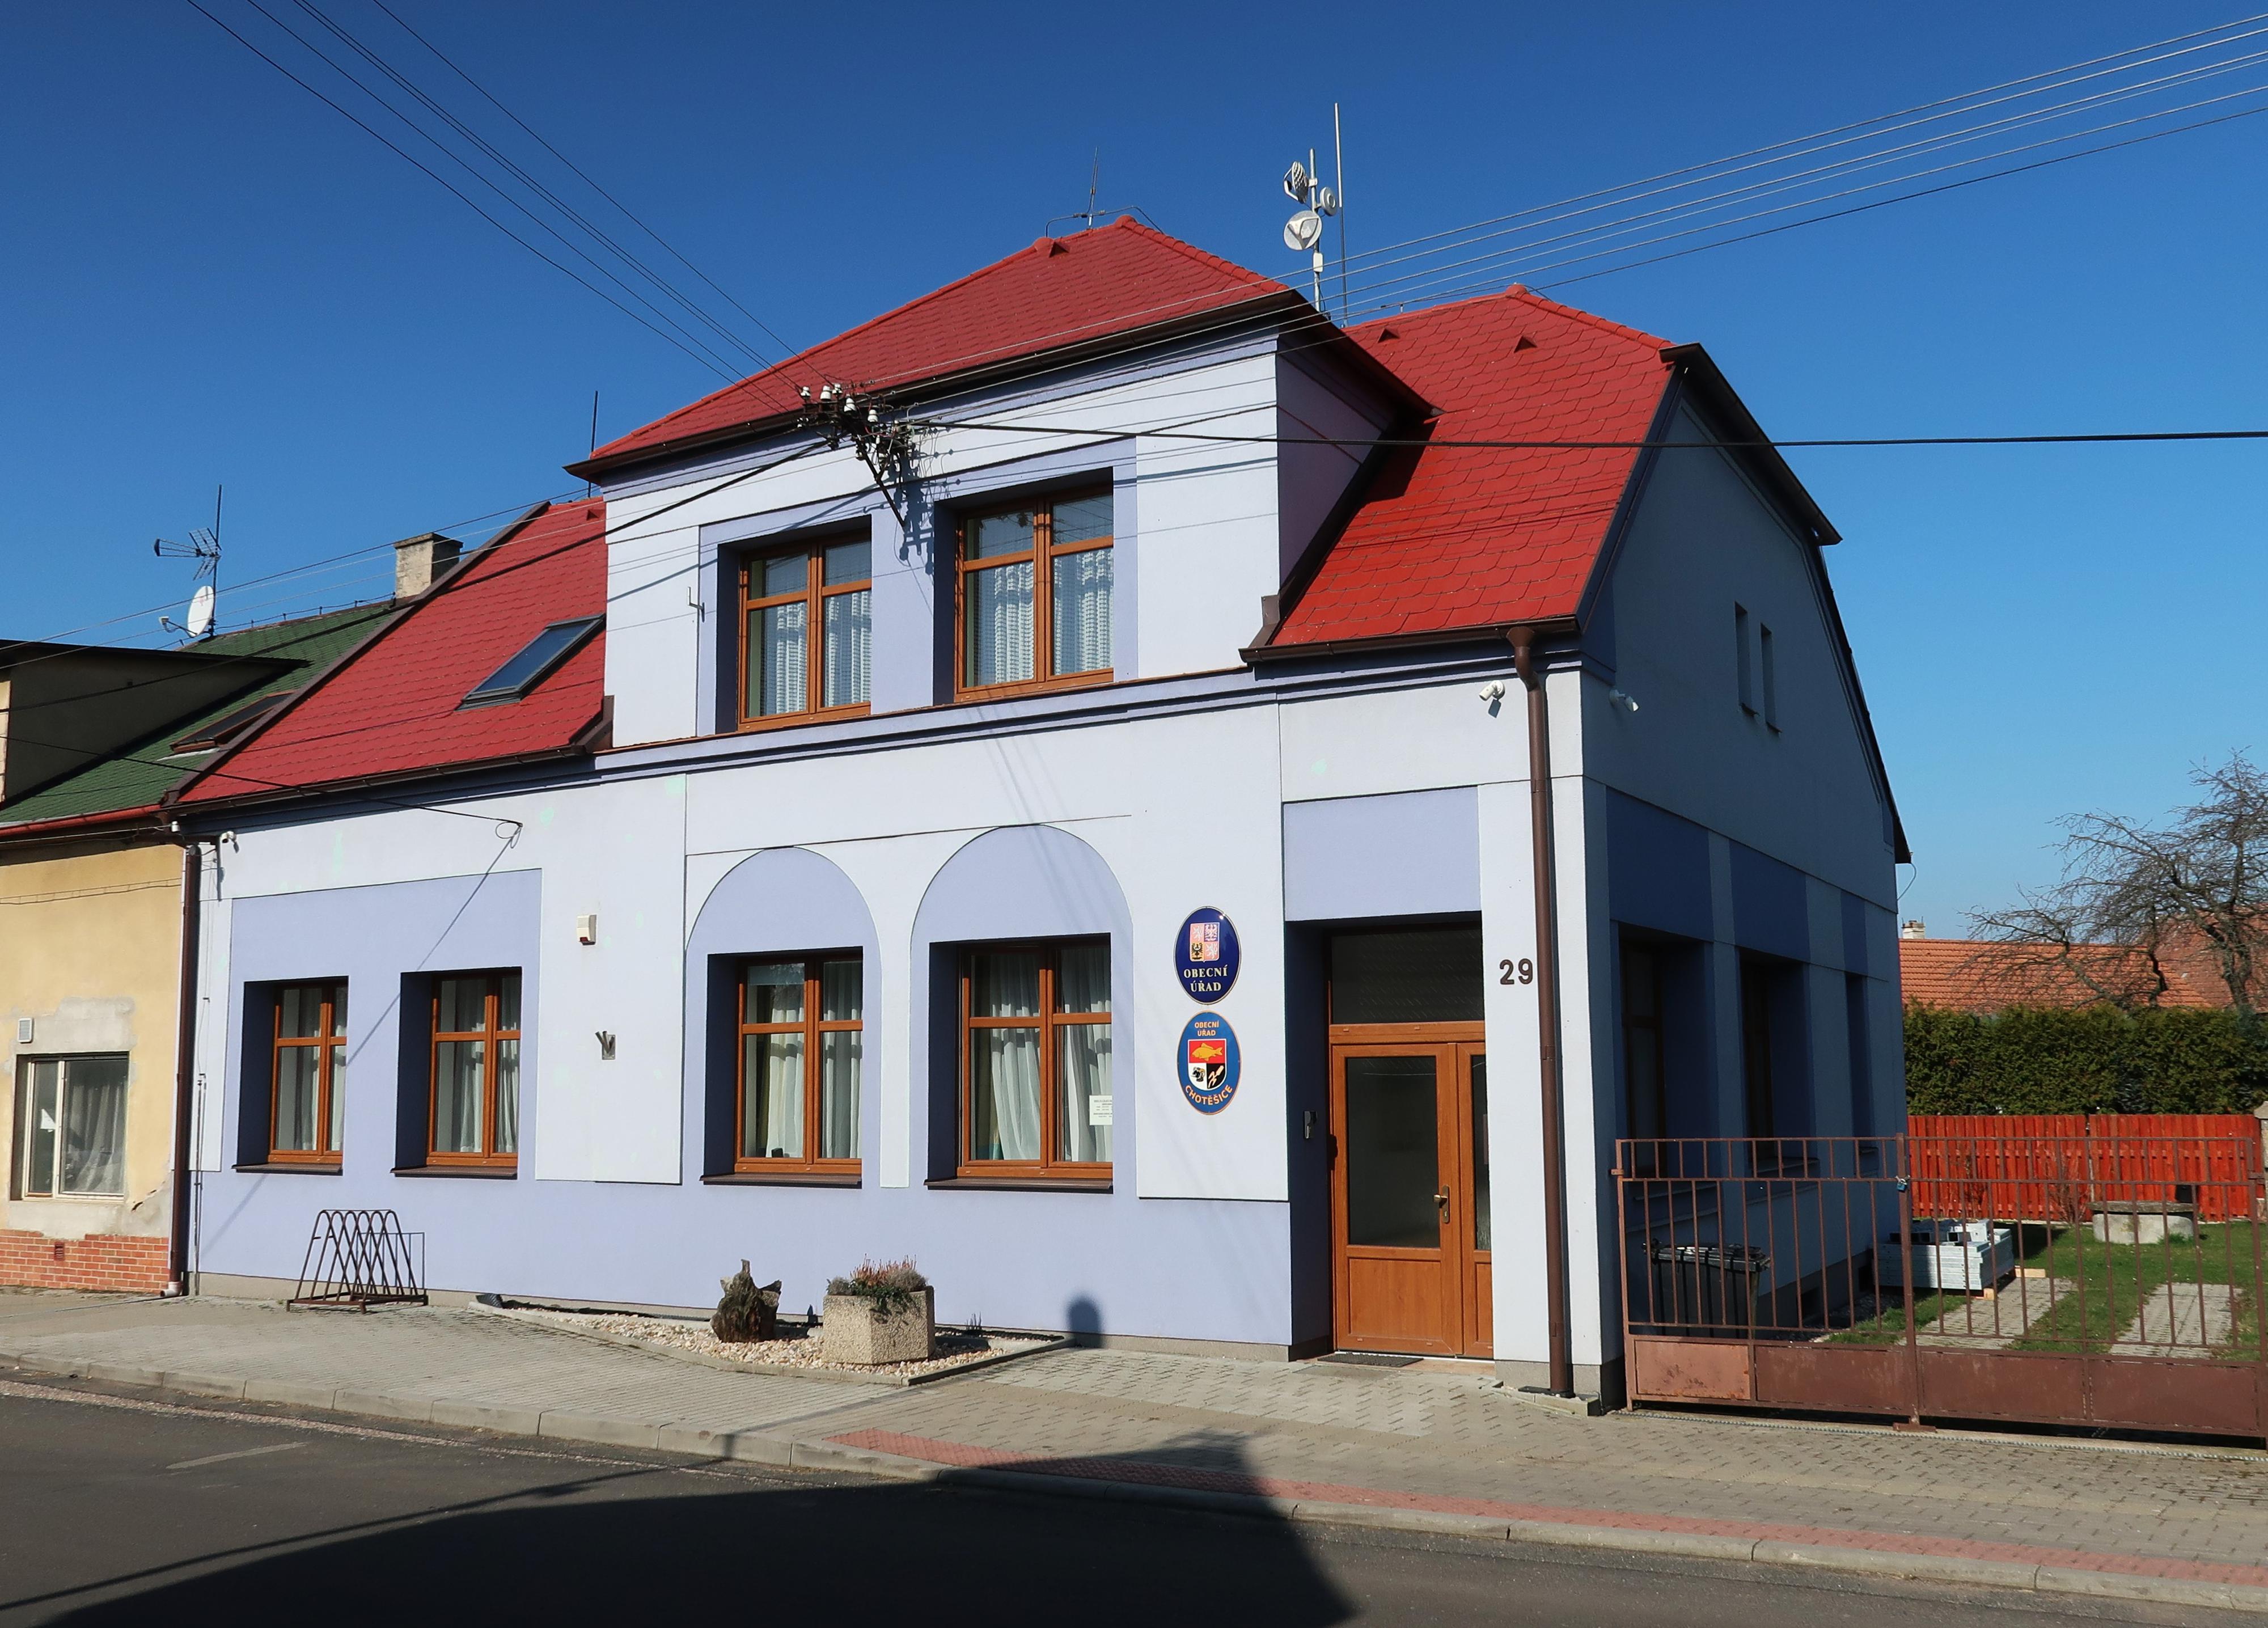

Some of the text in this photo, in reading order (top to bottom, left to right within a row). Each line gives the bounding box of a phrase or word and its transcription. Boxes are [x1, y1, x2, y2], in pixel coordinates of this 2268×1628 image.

[1183, 964, 1228, 978] OBECNÍ
[1499, 958, 1533, 985] 29
[1190, 980, 1221, 992] ÚŘAD
[1194, 1020, 1219, 1029] OBECNÍ
[1185, 1085, 1233, 1105] CHOTĚŠICE
